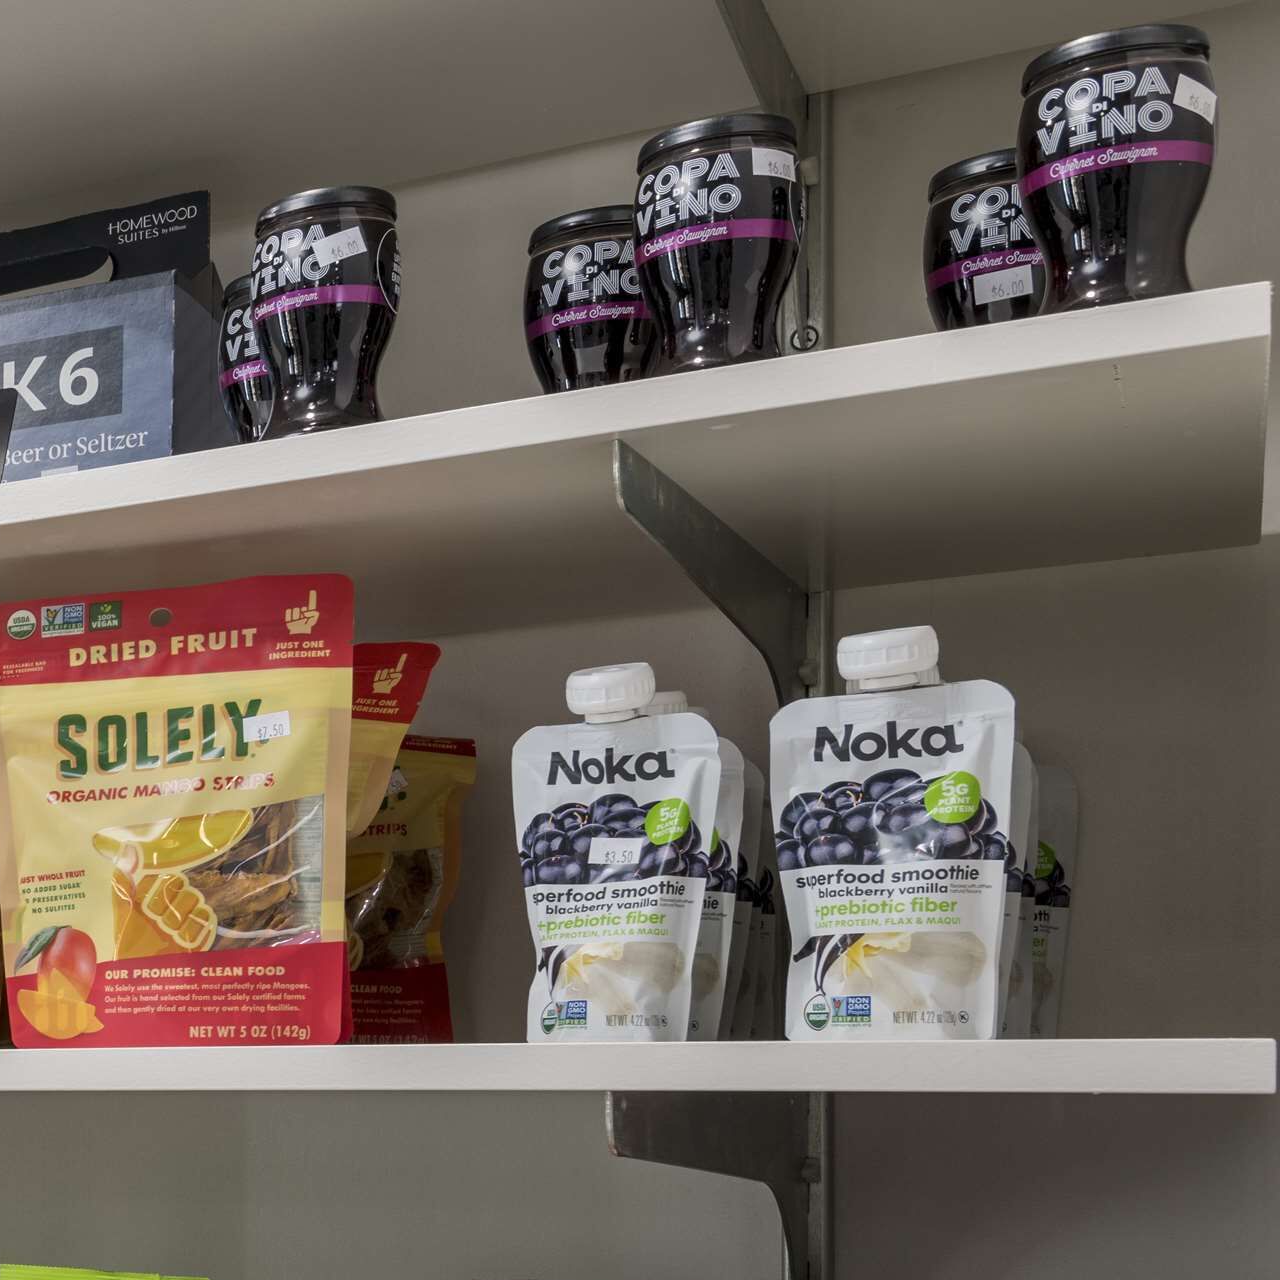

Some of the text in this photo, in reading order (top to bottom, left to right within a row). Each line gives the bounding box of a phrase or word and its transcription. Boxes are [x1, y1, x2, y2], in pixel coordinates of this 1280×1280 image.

[1038, 67, 1171, 122] COPA
[1037, 100, 1173, 155] VINO
[1050, 146, 1158, 178] Cabernet Sauvignon
[639, 153, 740, 205] COPA
[637, 184, 742, 236] VINO
[109, 205, 197, 236] HOMEWOOD
[118, 227, 159, 245] SUITES
[992, 280, 1024, 297] $6.00
[58, 347, 100, 406] 6
[49, 429, 148, 460] or Seltzer
[69, 628, 257, 668] DRIED FRUIT
[268, 650, 332, 661] INGREDIENT
[275, 640, 325, 651] JUST ONE
[257, 723, 285, 739] $7.50
[814, 721, 964, 762] Noka
[547, 748, 675, 785] Noka
[46, 772, 275, 805] ORGANIC STRIPS
[604, 850, 634, 864] $3.50
[65, 870, 86, 879] FRUIT
[796, 864, 980, 889] superfood smoothie
[611, 880, 685, 900] smoothie
[818, 886, 895, 900] blackberry
[899, 883, 948, 895] vanilla
[546, 902, 613, 916] blackberry
[616, 897, 658, 911] vanilla
[910, 896, 958, 913] fiber
[626, 911, 666, 926] fiber
[105, 966, 286, 980] OUR PROMISE: CLEAN FOOD
[190, 1024, 310, 1041] NET WT OZ (142g)
